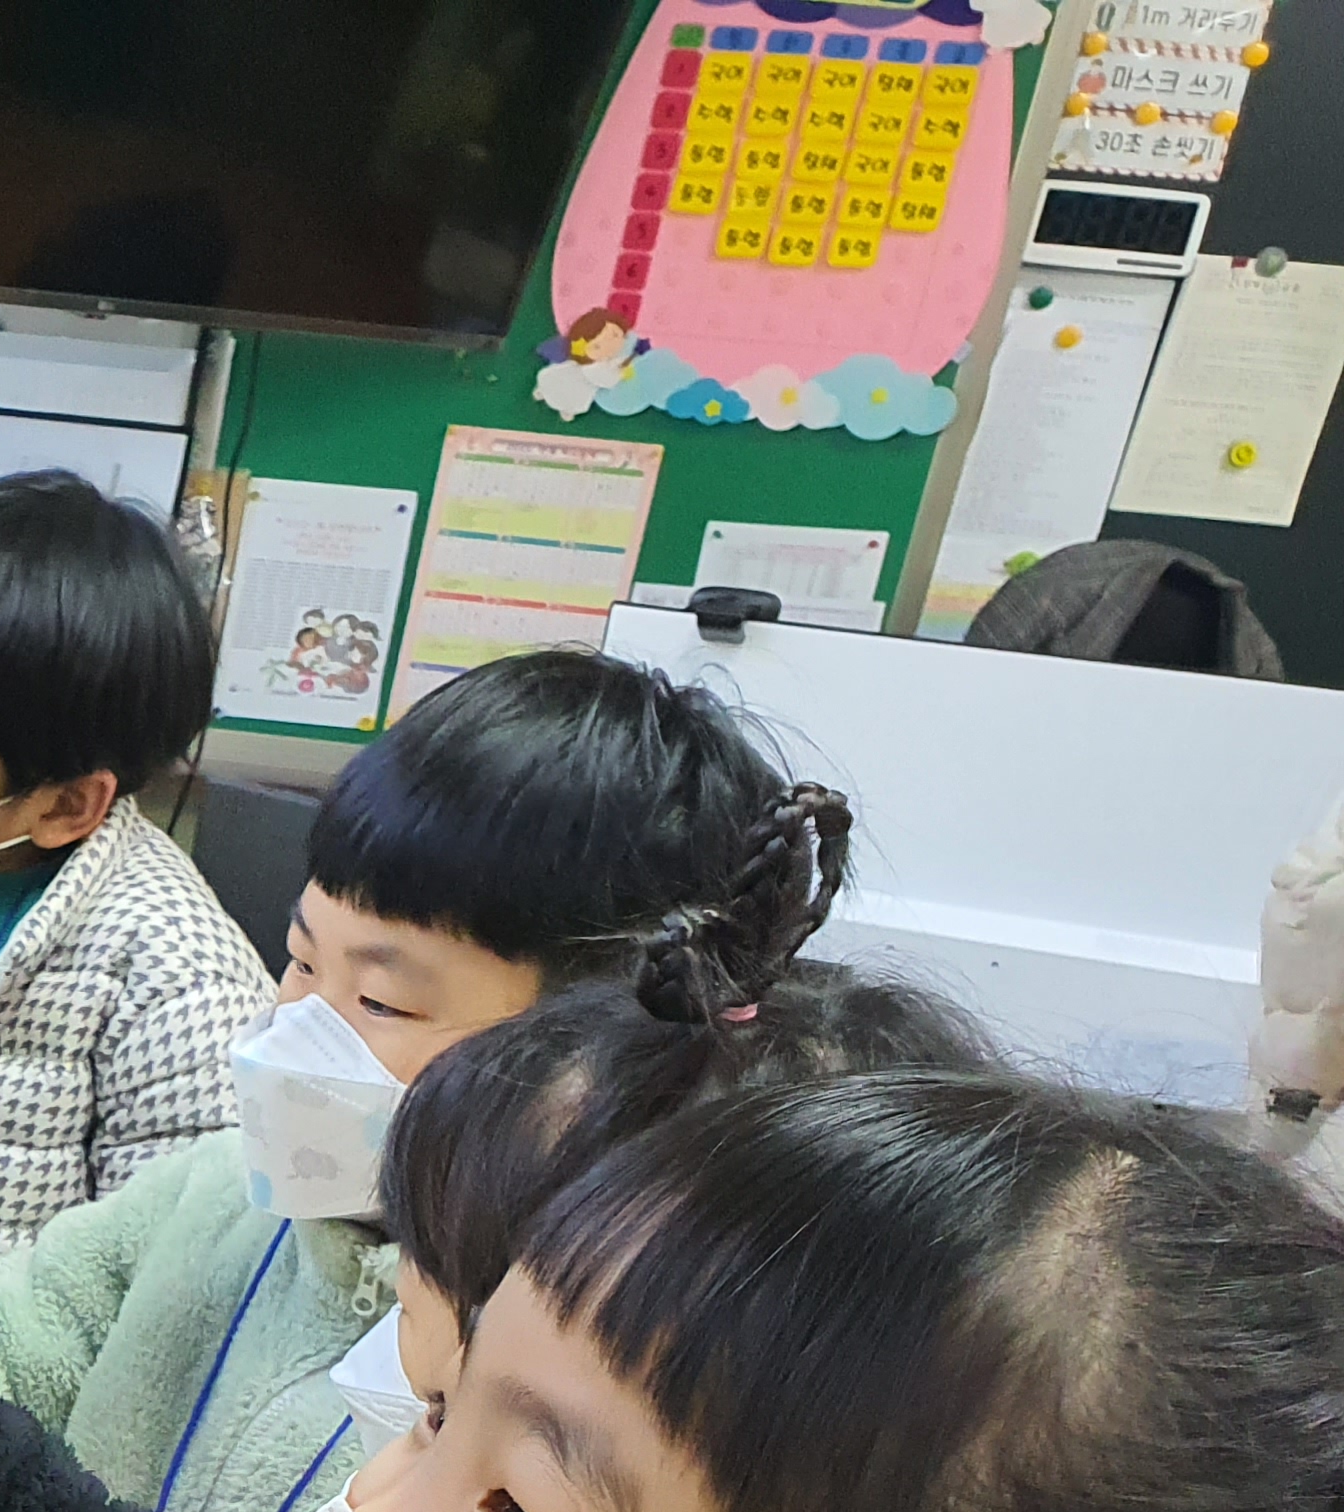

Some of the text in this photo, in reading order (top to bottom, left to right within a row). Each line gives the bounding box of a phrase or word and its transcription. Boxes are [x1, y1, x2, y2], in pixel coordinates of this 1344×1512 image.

[1140, 4, 1257, 34] 1m 거리두기
[1111, 65, 1234, 100] 마스크 쓰기
[1095, 130, 1217, 161] 30초 손씻기
